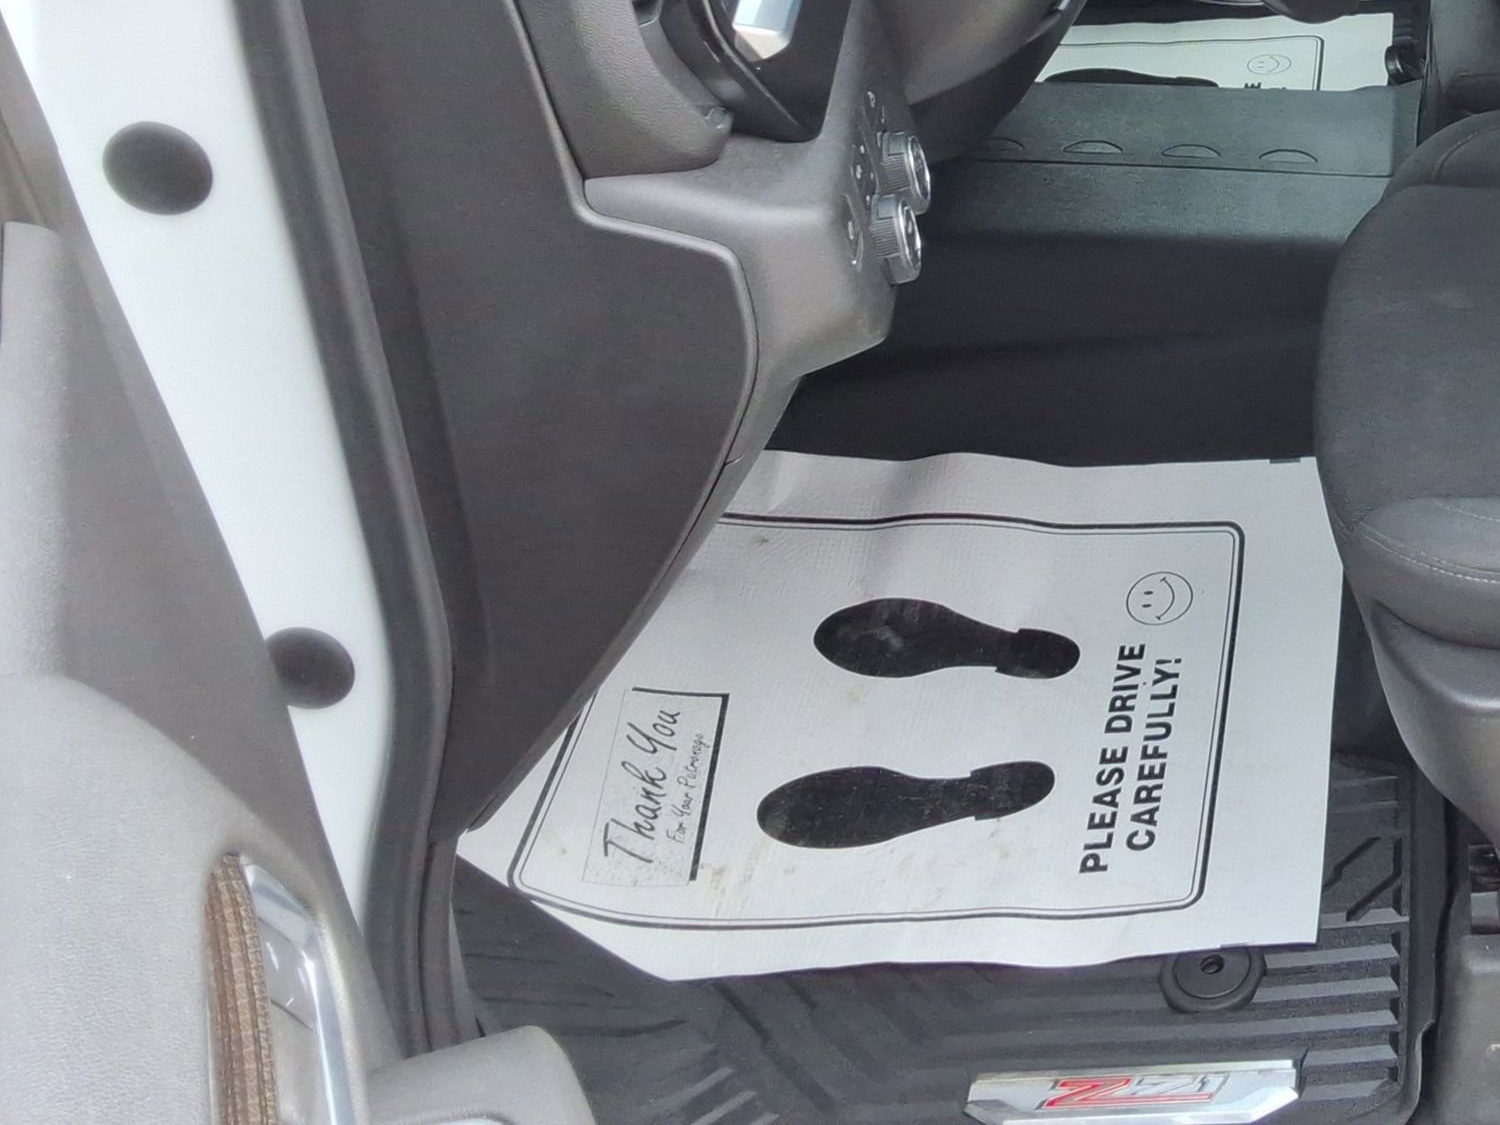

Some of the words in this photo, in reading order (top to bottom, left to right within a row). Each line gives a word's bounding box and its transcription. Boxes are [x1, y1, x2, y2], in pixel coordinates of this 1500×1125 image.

[626, 709, 681, 755] You
[1125, 658, 1182, 852] CAREFULLY!
[676, 733, 711, 789] Patronage
[1079, 746, 1128, 874] PLEASE
[1104, 644, 1146, 734] DRIVE
[603, 760, 667, 863] Thank
[671, 791, 694, 818] Your
[666, 821, 685, 844] For
[1036, 1073, 1230, 1110] Z71
